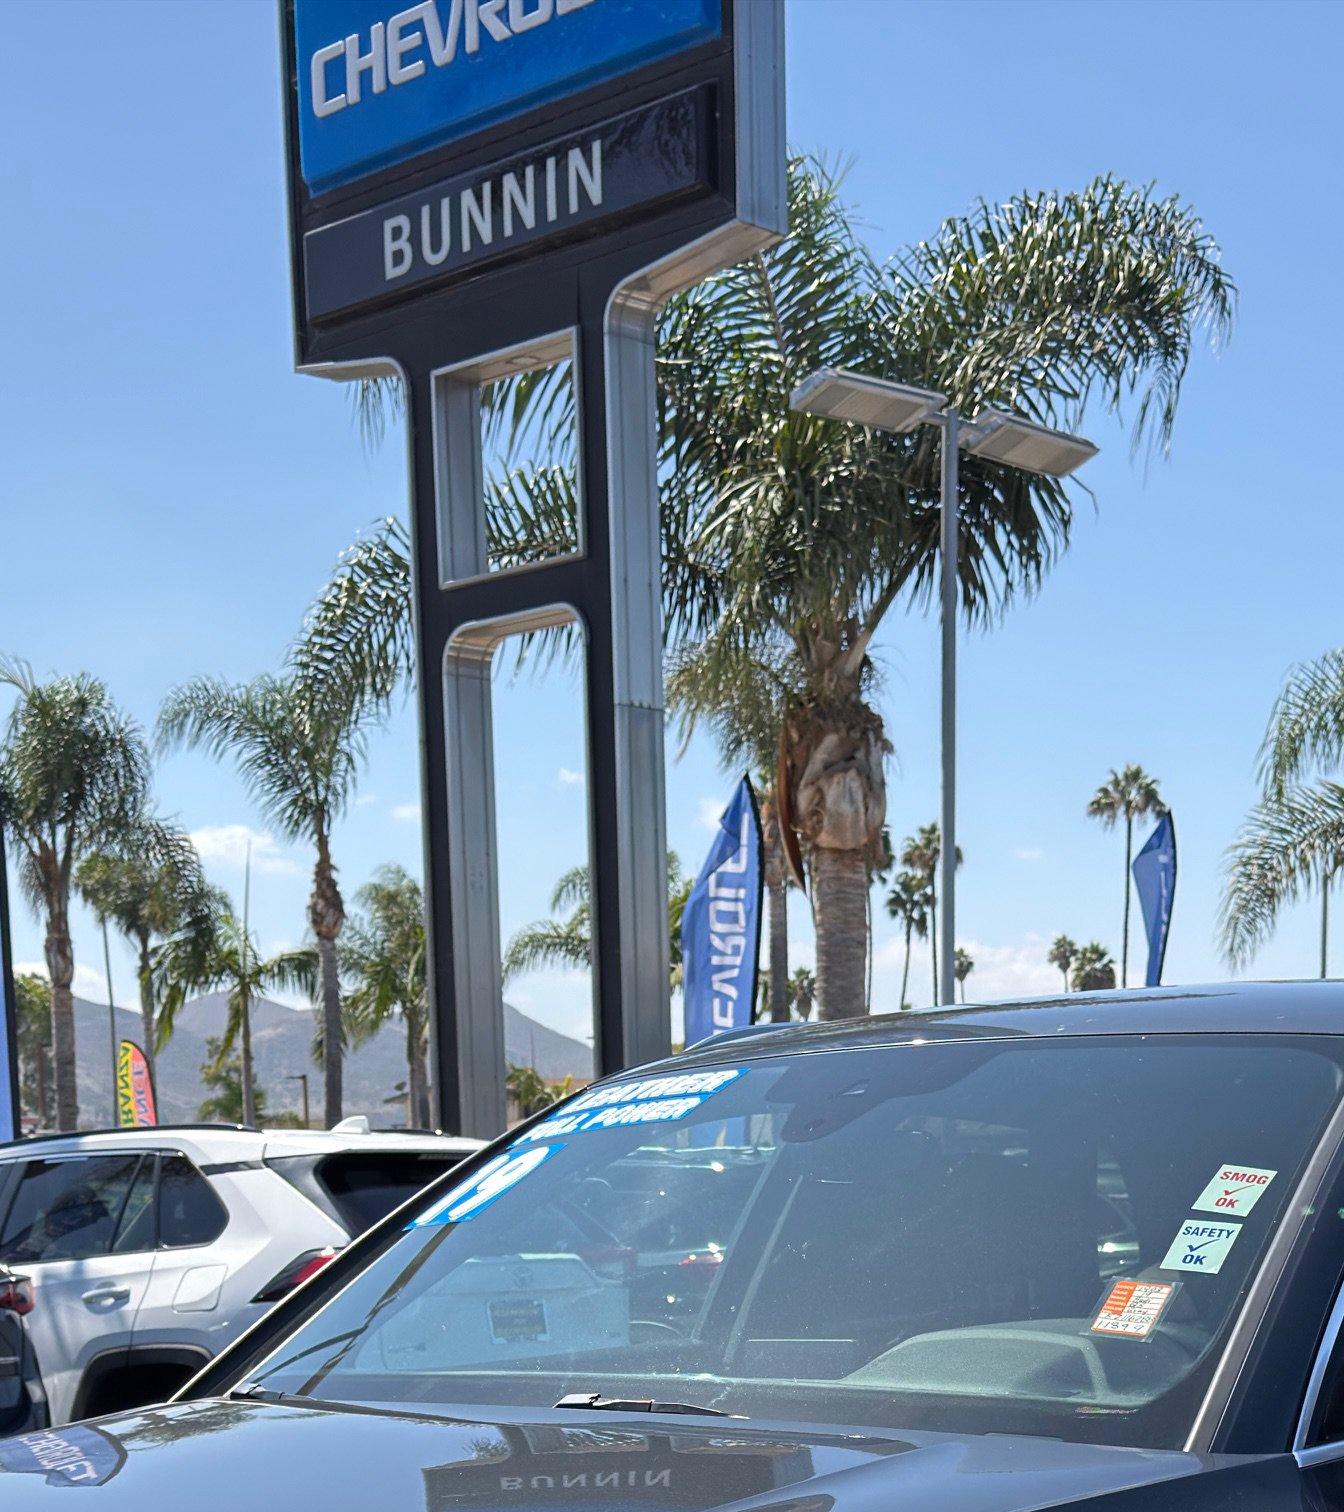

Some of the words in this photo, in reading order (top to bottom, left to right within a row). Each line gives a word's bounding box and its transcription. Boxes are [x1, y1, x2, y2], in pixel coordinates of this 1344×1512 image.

[383, 138, 604, 282] BUNNIN
[558, 1069, 741, 1116] LEATHER
[511, 1112, 589, 1148] FULL
[580, 1096, 702, 1131] POWER
[414, 1146, 550, 1226] 19
[1219, 1170, 1269, 1186] SMOG
[1214, 1196, 1240, 1209] OK
[1181, 1225, 1236, 1240] SAFETY
[1181, 1253, 1207, 1266] OK
